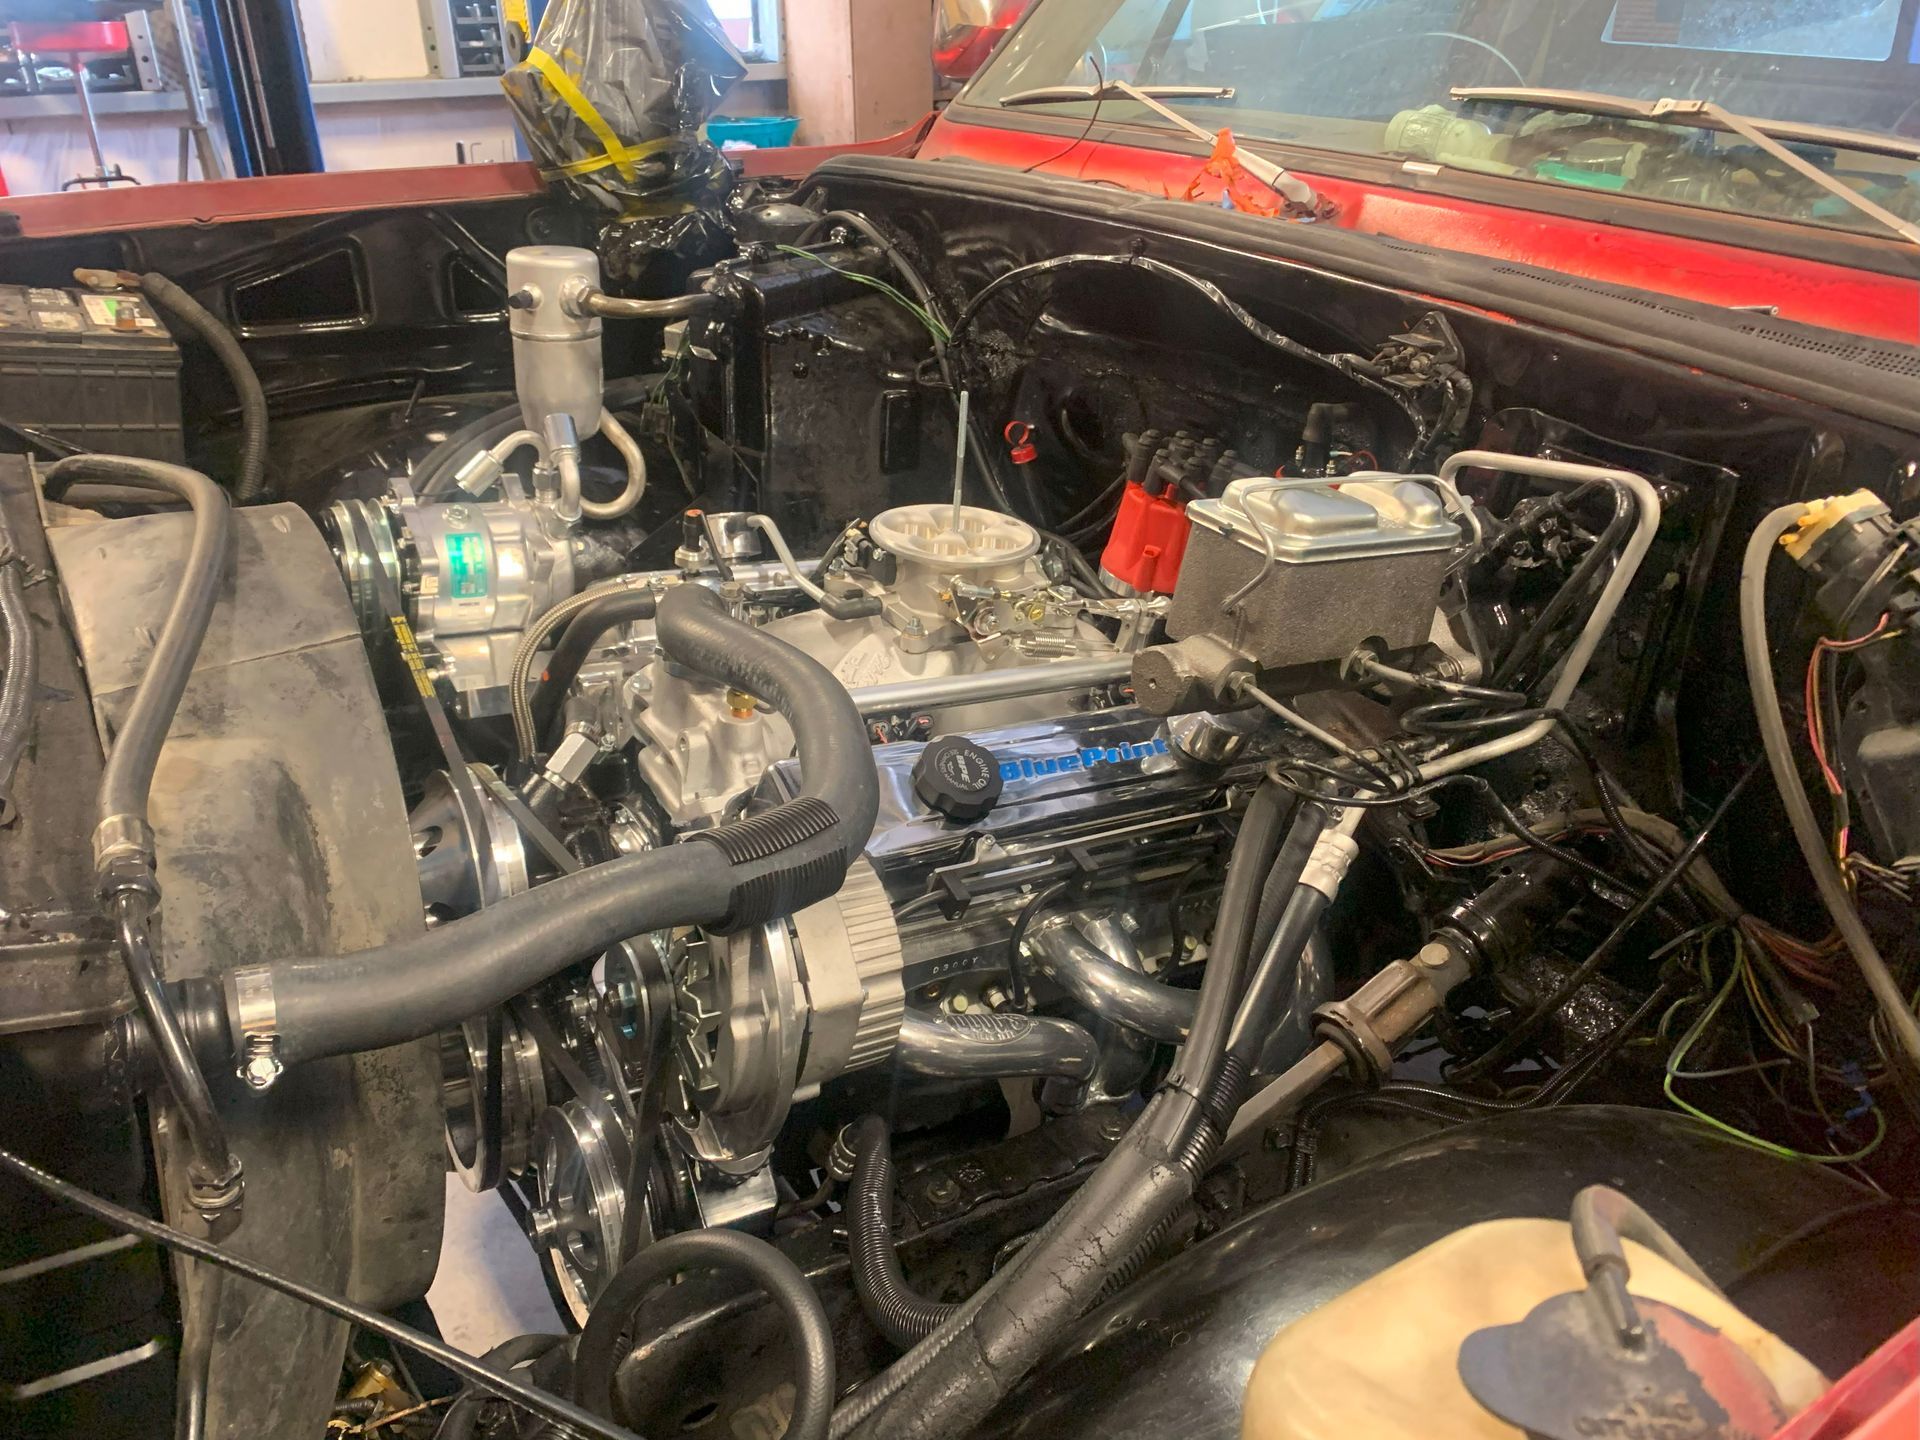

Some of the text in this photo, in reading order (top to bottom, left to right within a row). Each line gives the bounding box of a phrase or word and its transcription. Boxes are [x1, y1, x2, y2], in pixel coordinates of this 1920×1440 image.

[963, 749, 990, 790] ENGINE OIL
[999, 738, 1169, 782] BluePrint
